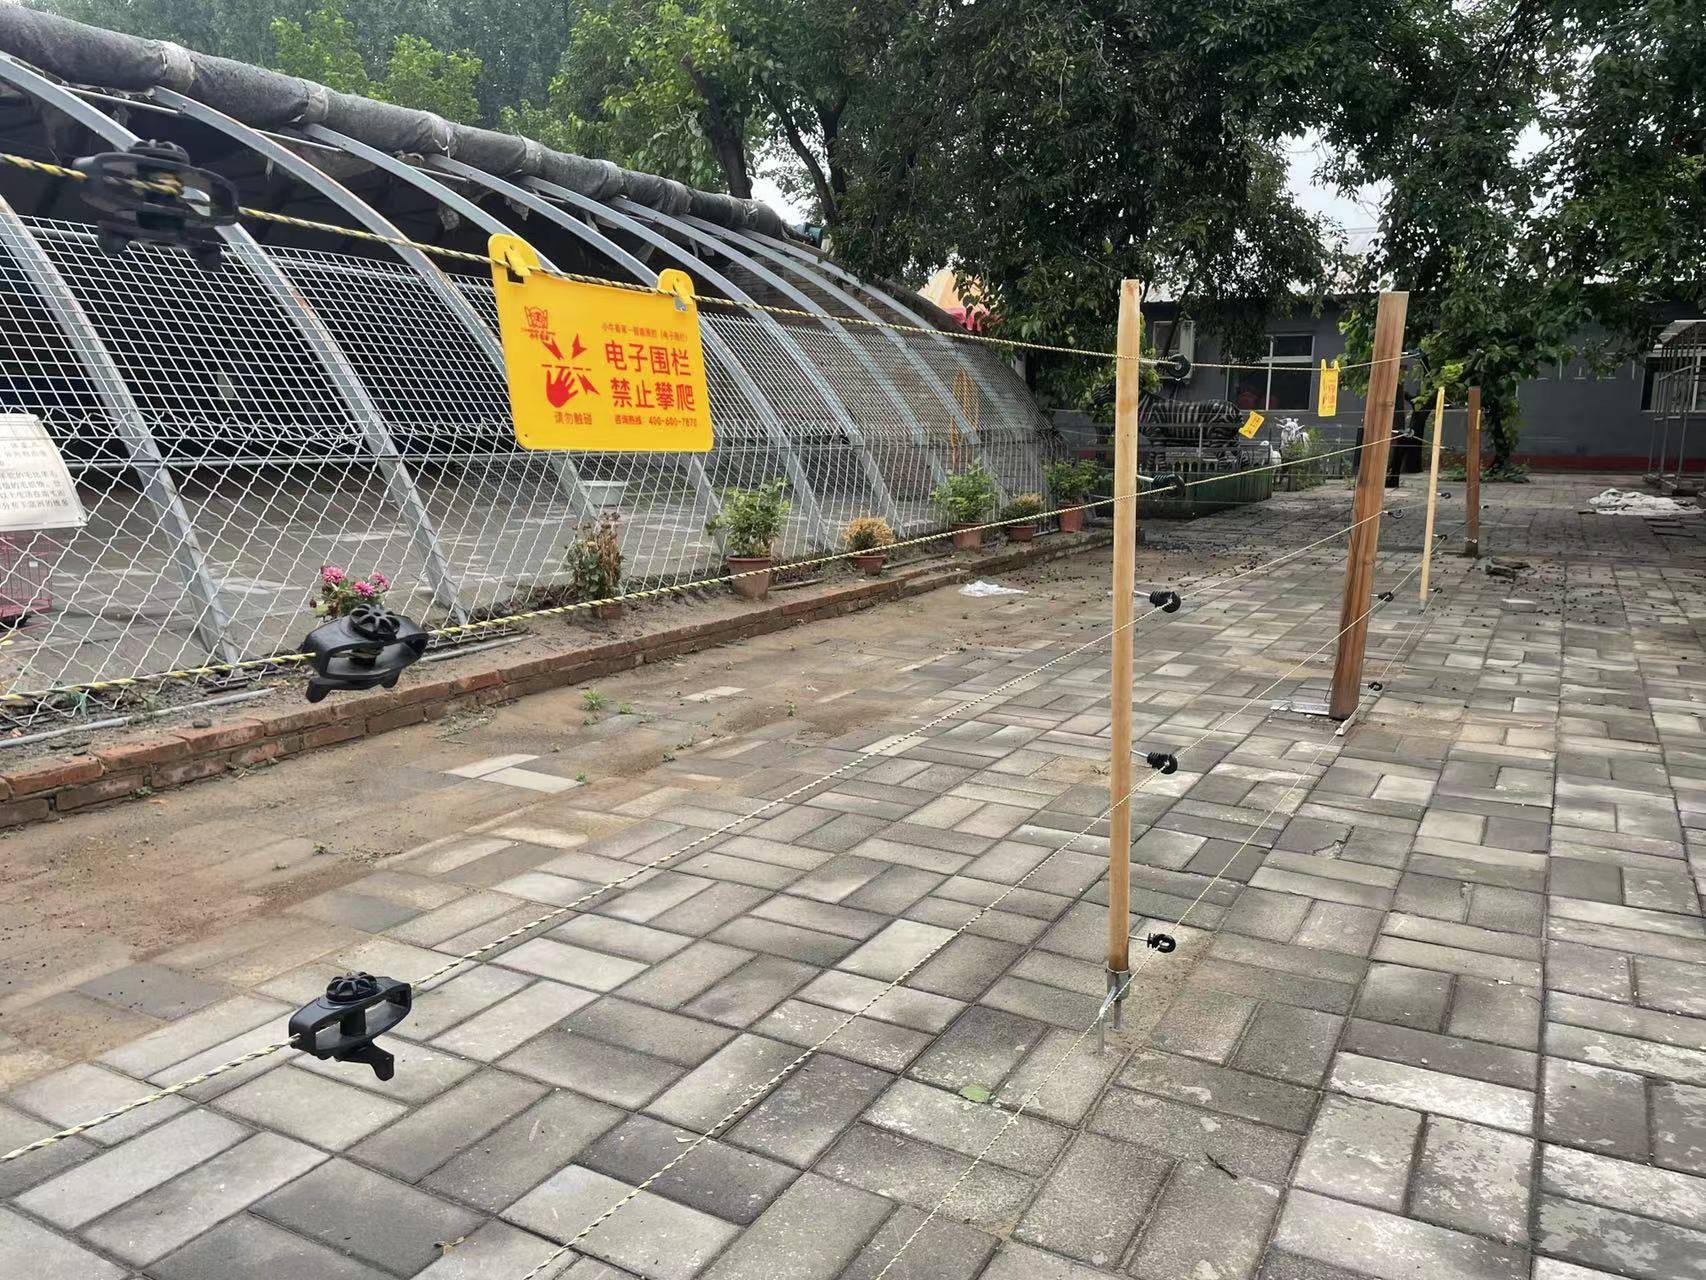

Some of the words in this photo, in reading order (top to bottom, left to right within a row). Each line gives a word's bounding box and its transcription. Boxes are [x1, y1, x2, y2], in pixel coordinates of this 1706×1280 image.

[605, 340, 691, 376] 电子围栏
[610, 377, 696, 411] 禁止攀爬
[554, 411, 593, 425] 请勿触碰
